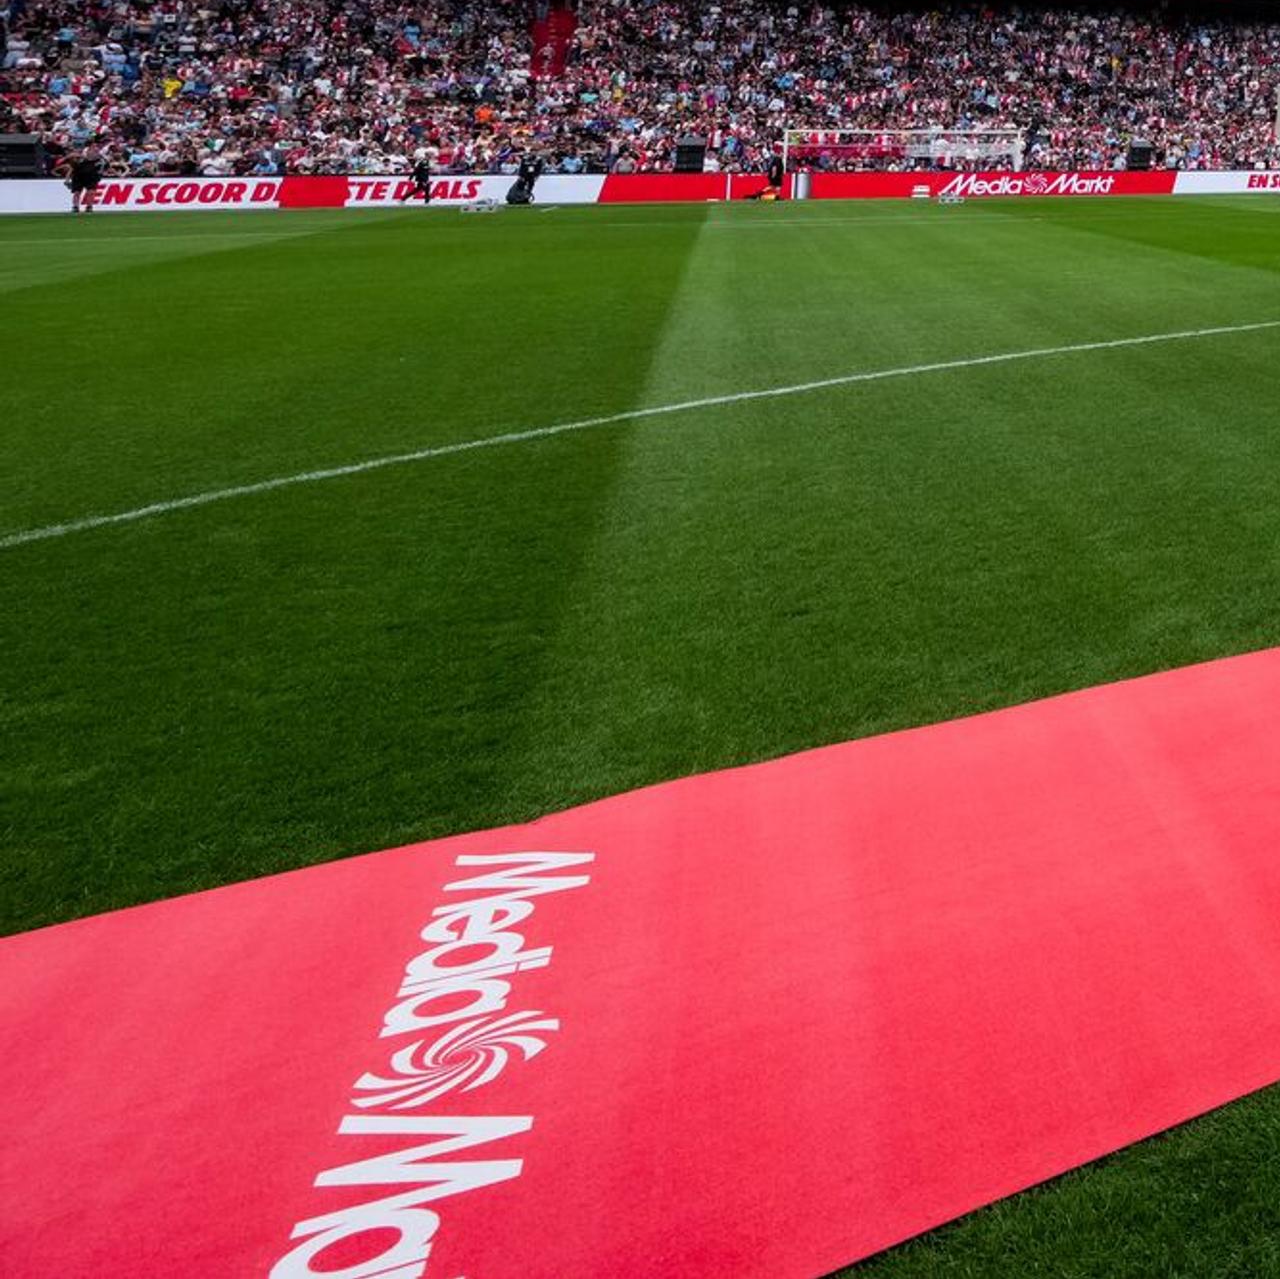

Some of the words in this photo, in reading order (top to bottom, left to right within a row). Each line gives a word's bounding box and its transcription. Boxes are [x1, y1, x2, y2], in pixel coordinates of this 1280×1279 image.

[938, 173, 1025, 197] Media
[1045, 173, 1115, 196] Markt
[1247, 174, 1269, 189] EN
[135, 182, 248, 205] SCOOR
[378, 851, 596, 1038] Media
